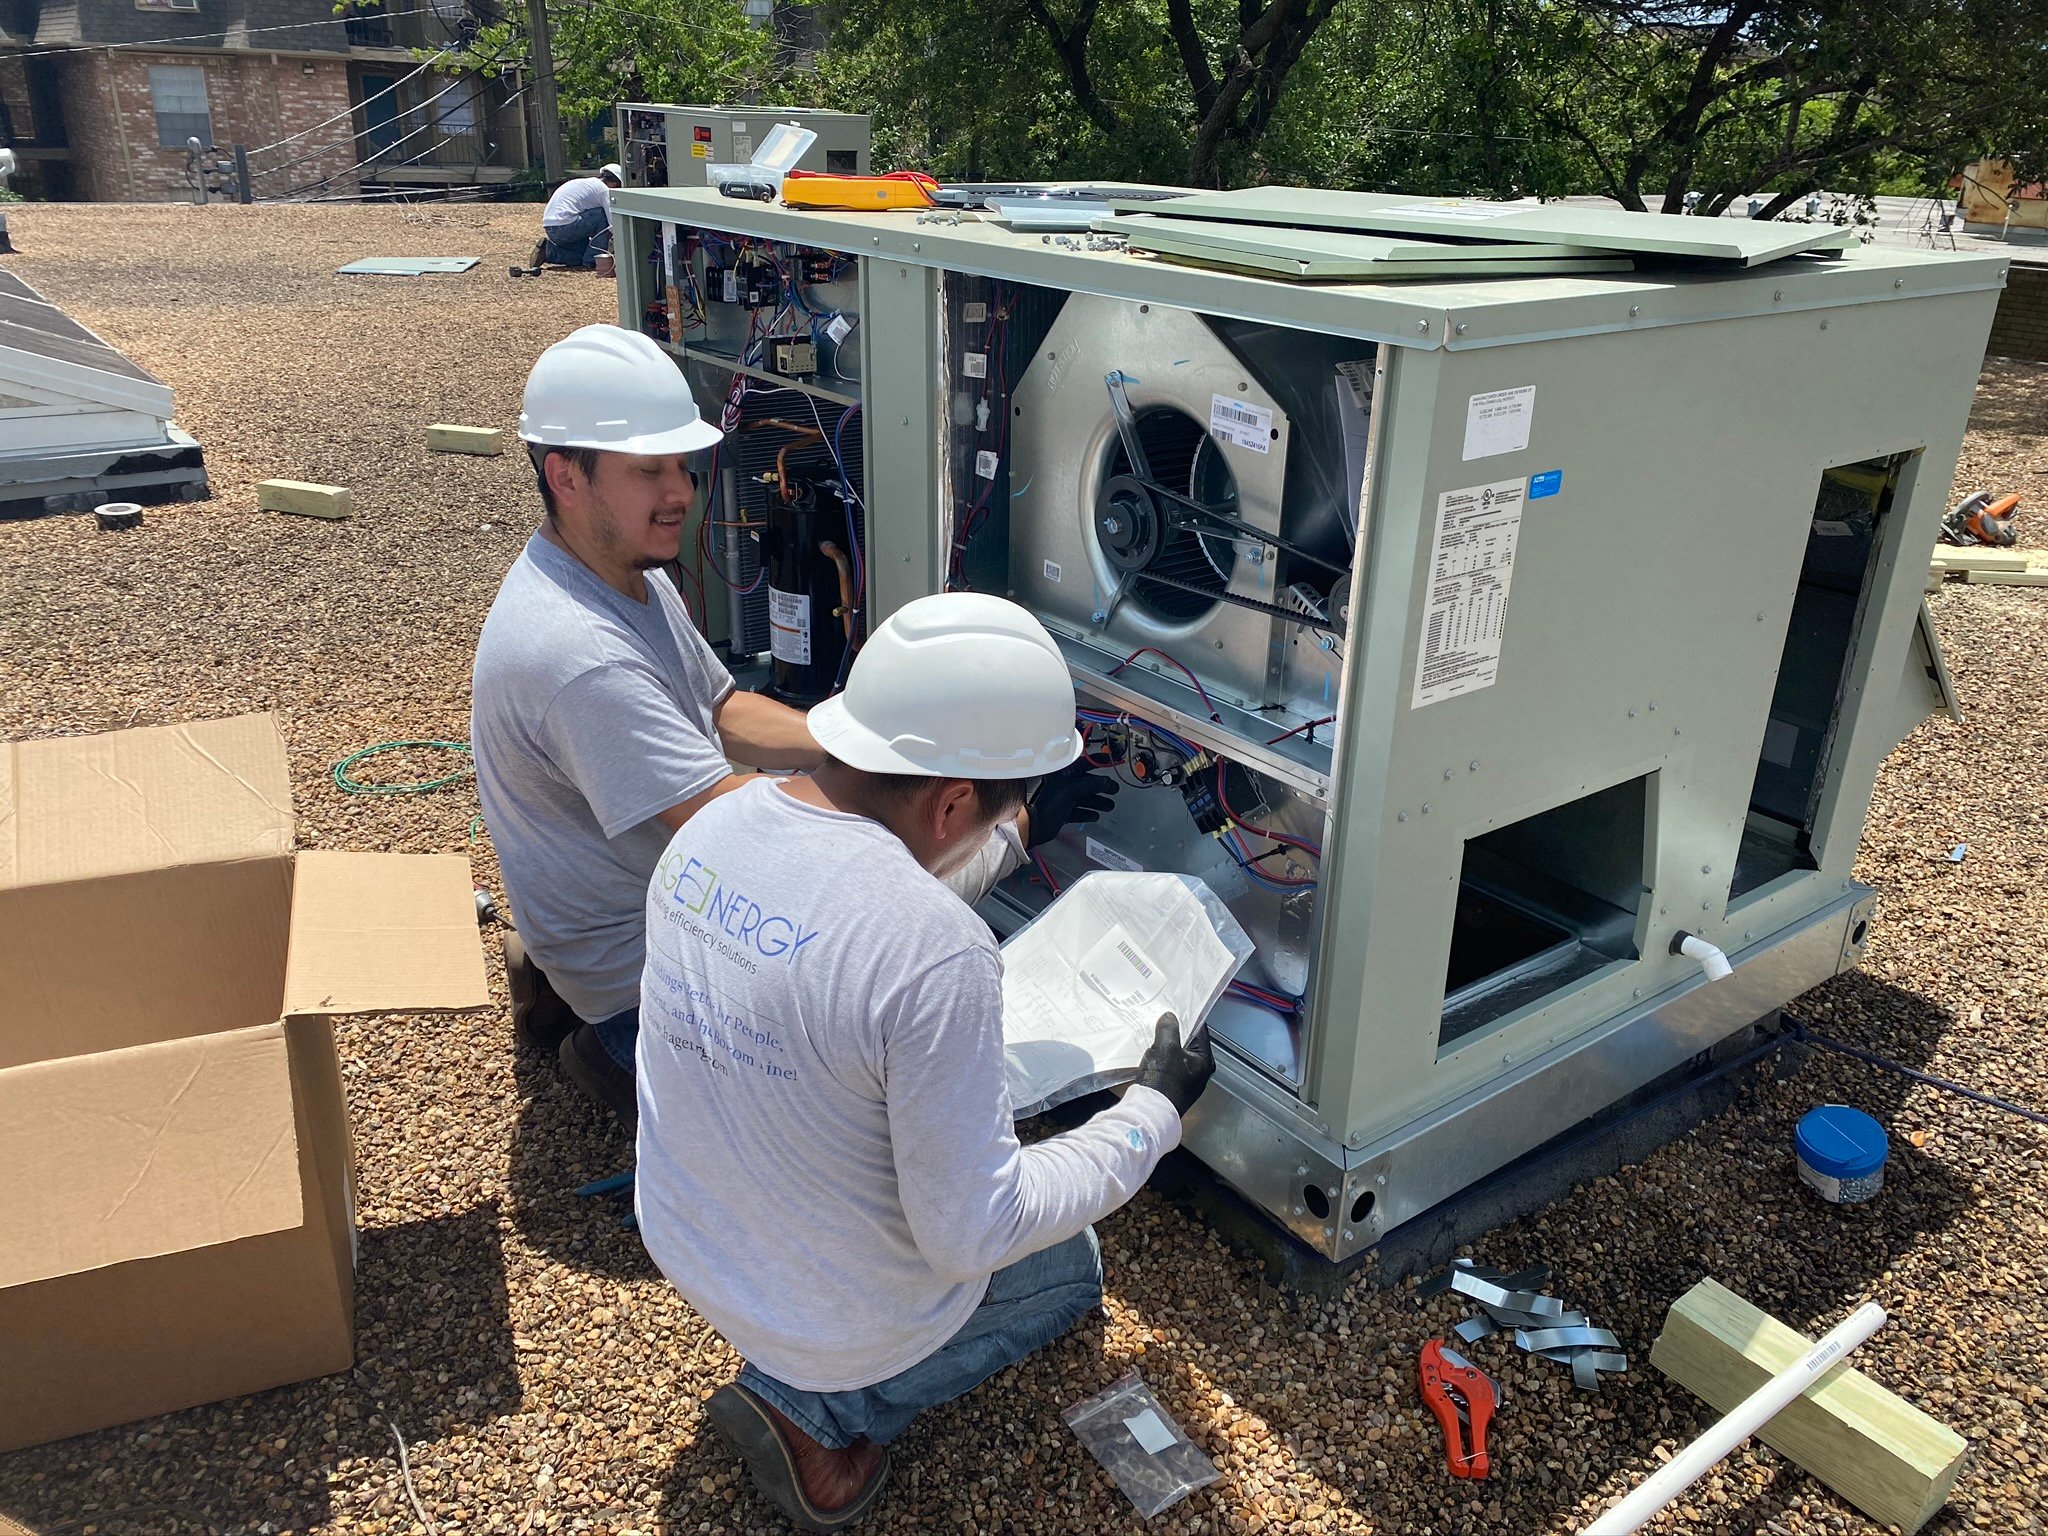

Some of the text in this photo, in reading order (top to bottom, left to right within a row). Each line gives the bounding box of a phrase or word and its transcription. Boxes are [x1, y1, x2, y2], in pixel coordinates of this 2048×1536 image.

[669, 910, 717, 949] efficiency
[717, 940, 758, 975] solutions
[671, 1008, 696, 1025] and
